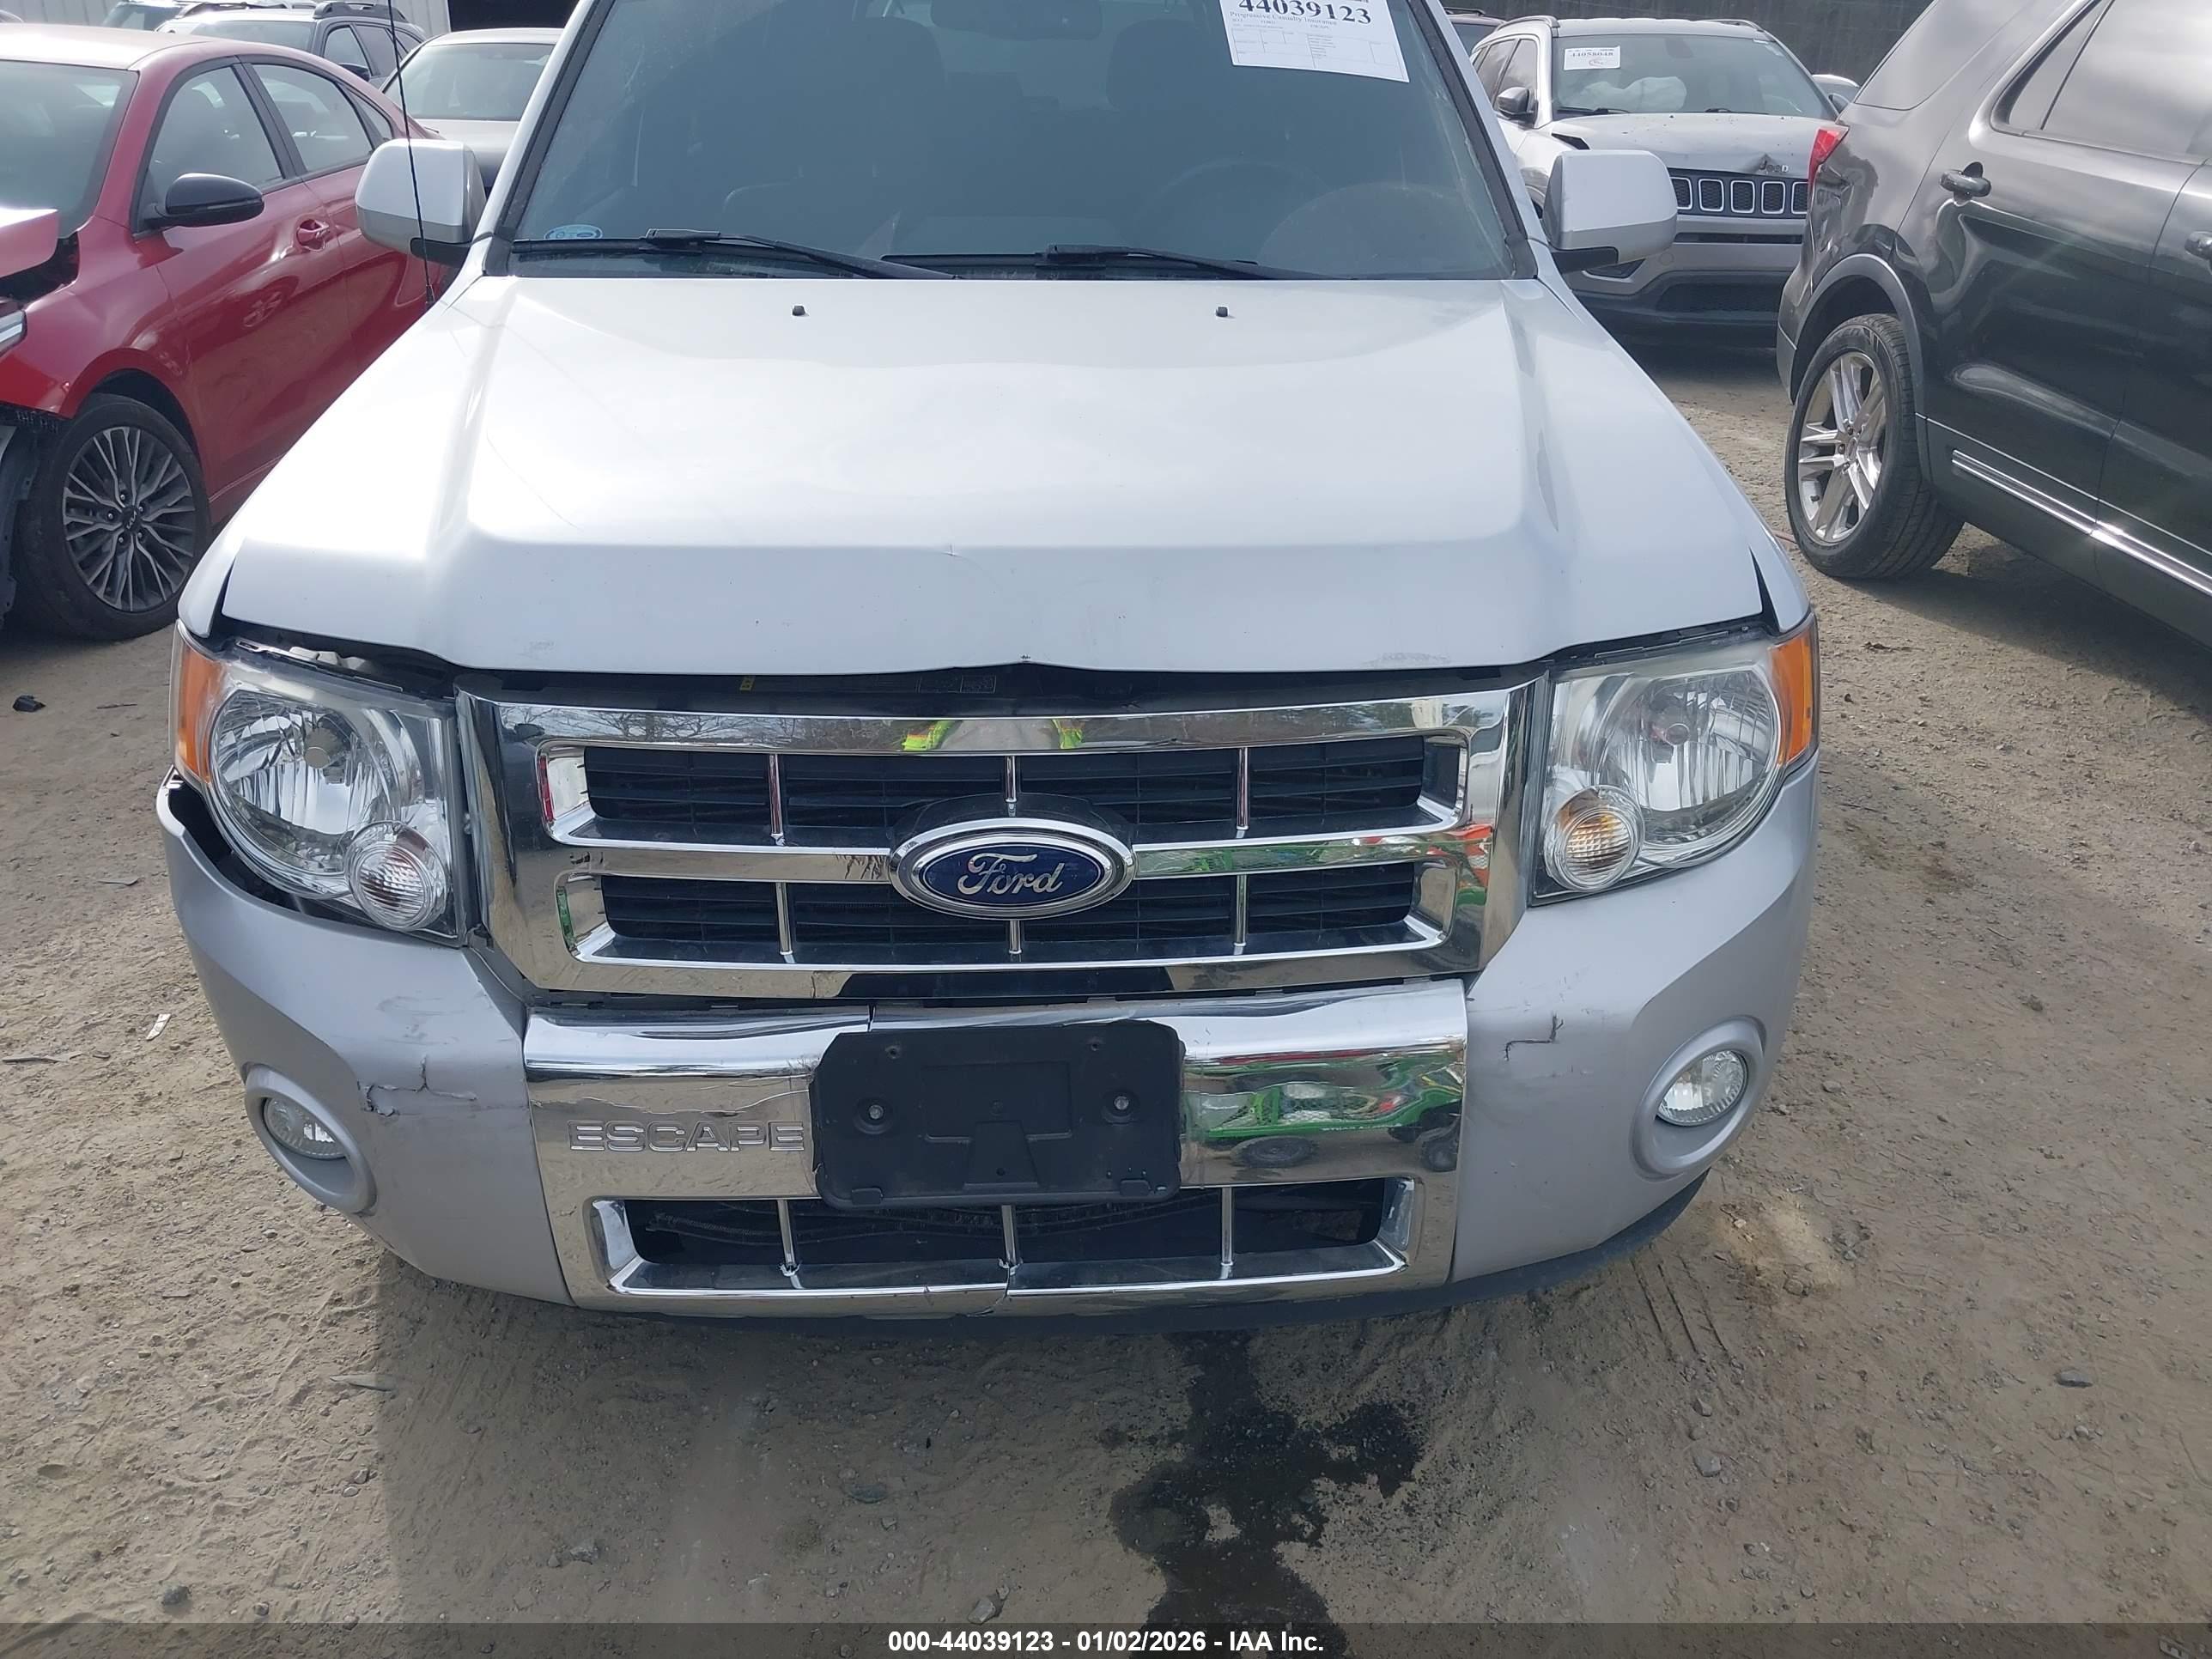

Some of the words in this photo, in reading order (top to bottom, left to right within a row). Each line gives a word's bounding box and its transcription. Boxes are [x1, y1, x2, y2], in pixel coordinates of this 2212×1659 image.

[1239, 0, 1372, 25] 44039123
[957, 853, 1065, 895] Ford
[568, 1120, 805, 1152] ESCAPE
